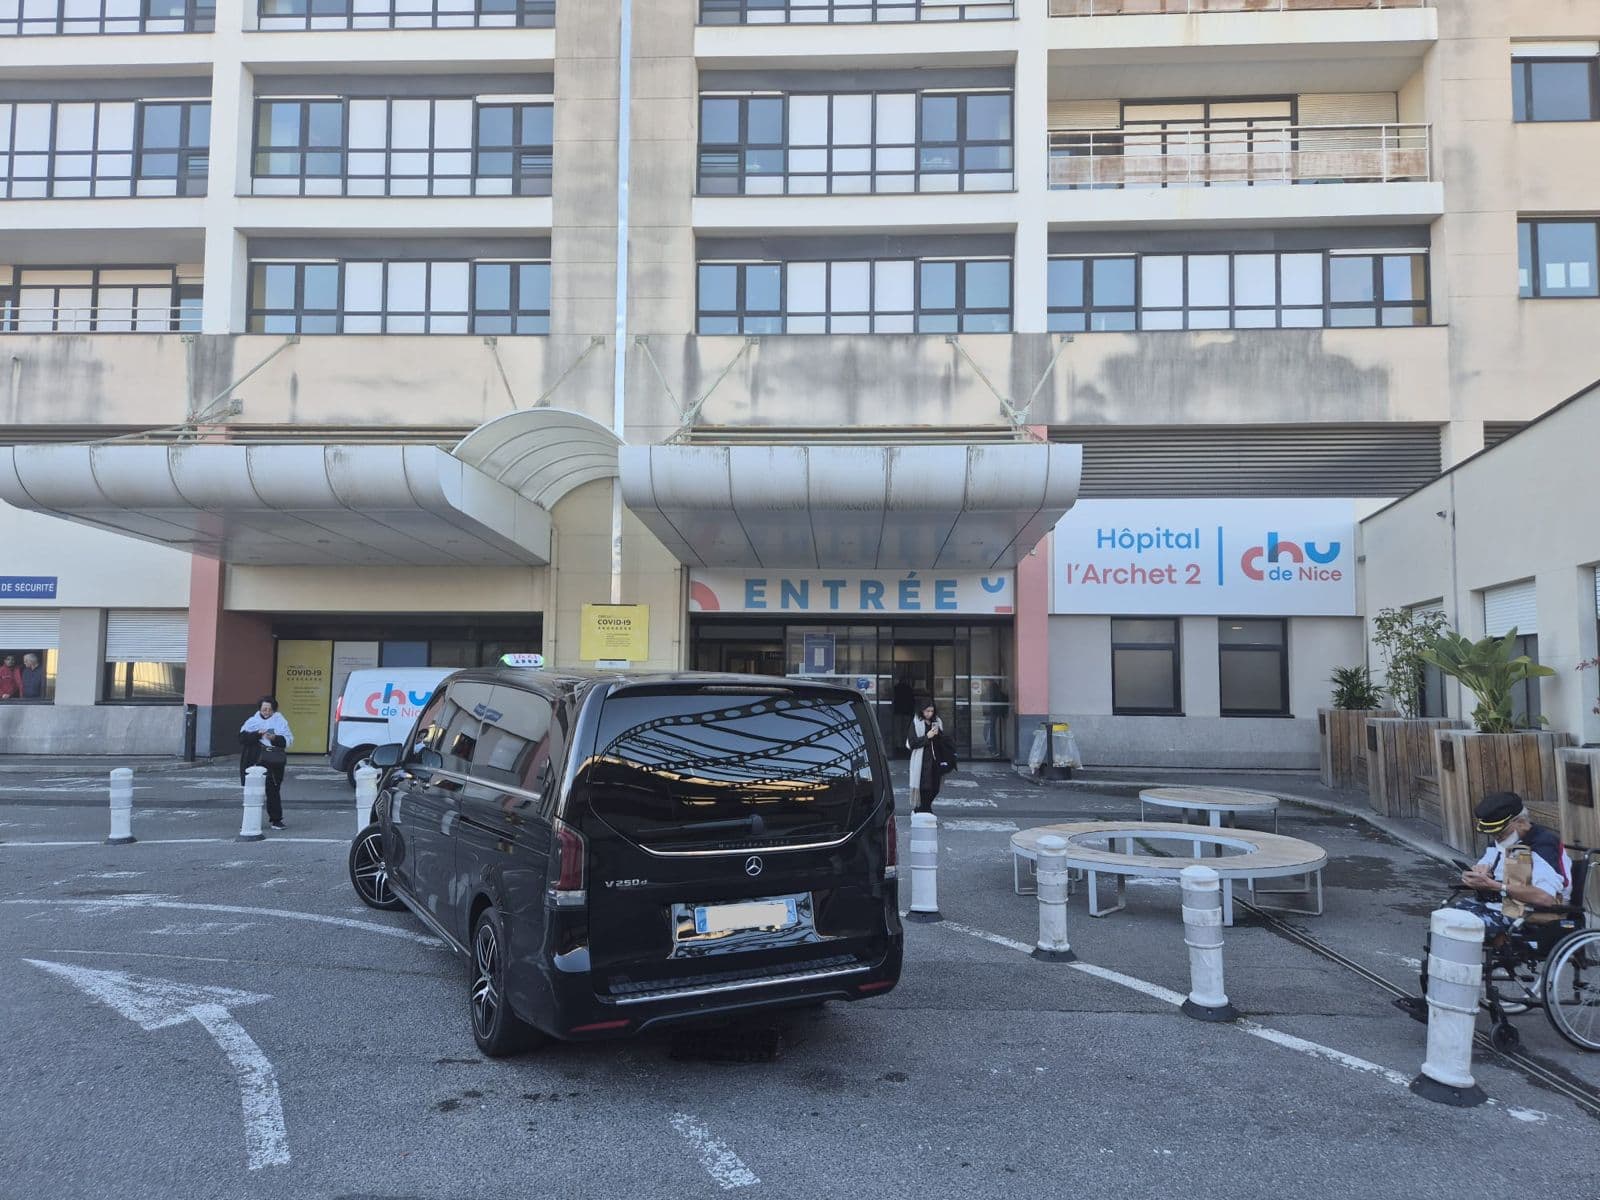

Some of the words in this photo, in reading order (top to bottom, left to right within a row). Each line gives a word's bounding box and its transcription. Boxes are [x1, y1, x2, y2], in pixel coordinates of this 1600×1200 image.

[1097, 527, 1200, 554] Hôpital
[1241, 531, 1341, 581] chu
[1185, 564, 1201, 585] 2
[1269, 566, 1292, 581] de
[1299, 566, 1342, 581] Nice
[1, 583, 12, 592] DE
[744, 571, 958, 610] ENTRÉE
[381, 705, 398, 717] de
